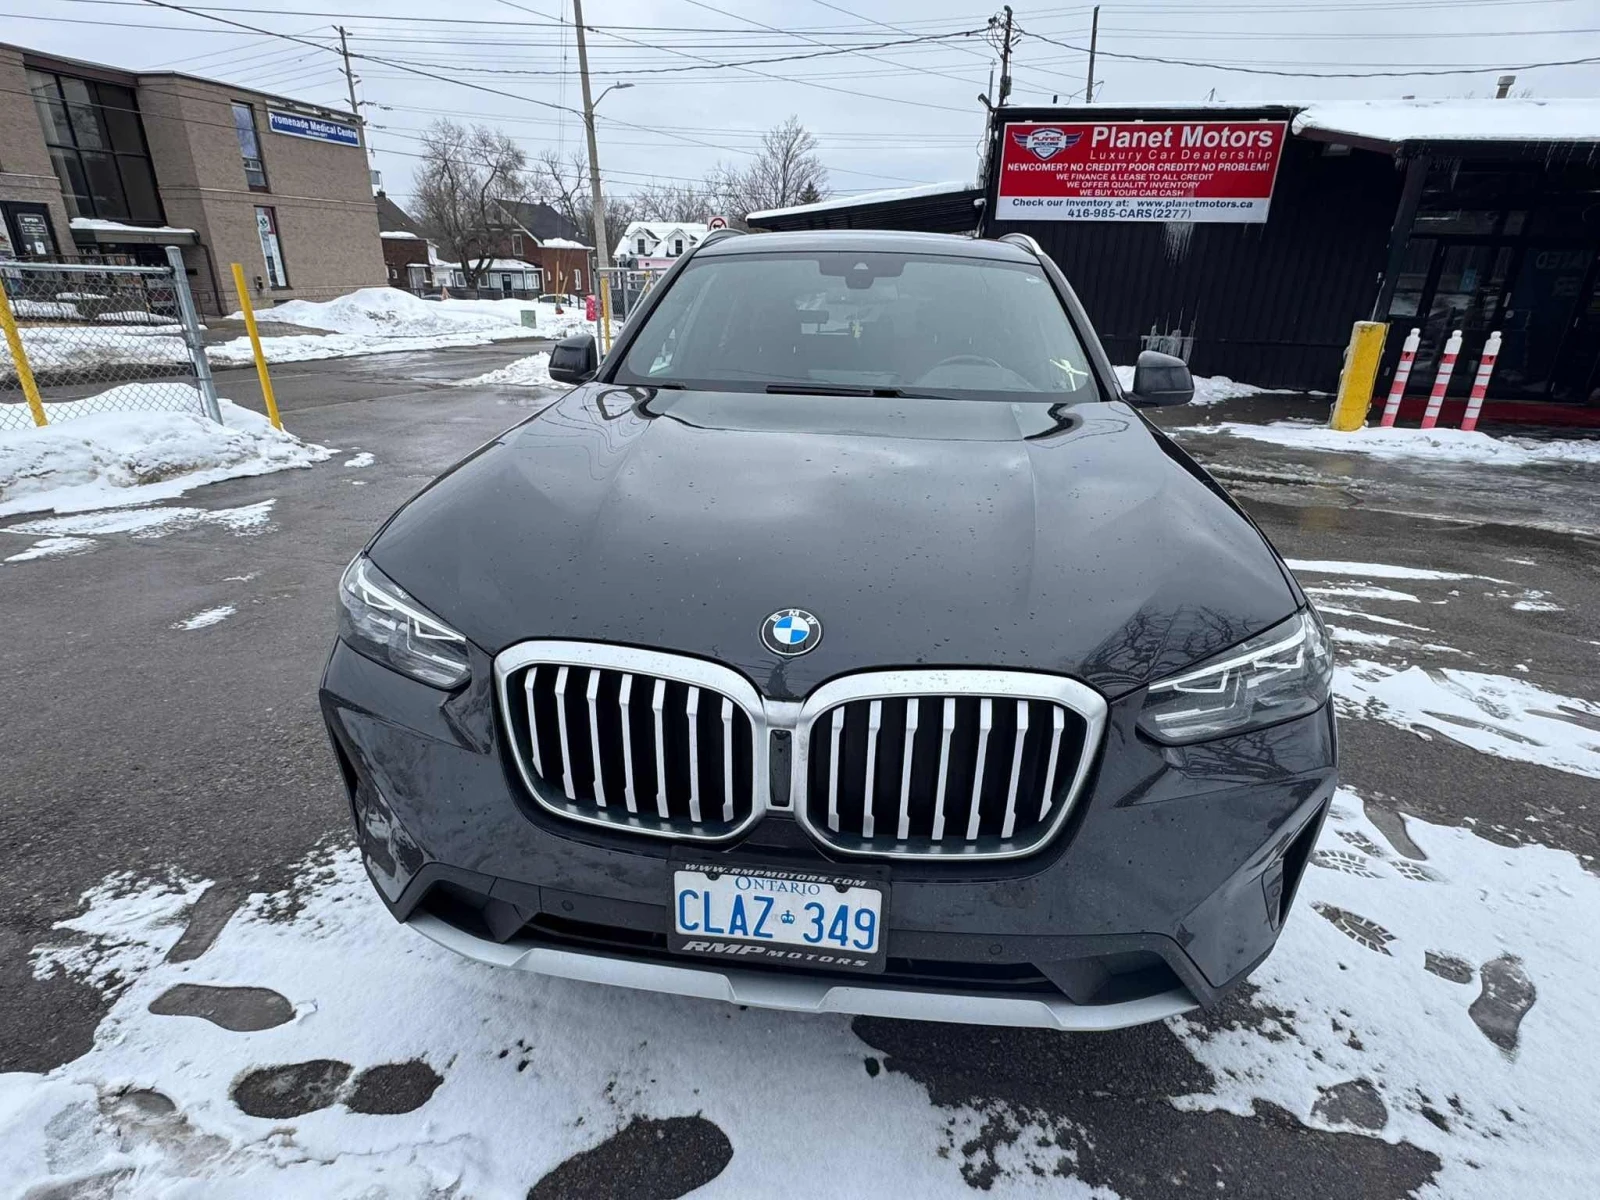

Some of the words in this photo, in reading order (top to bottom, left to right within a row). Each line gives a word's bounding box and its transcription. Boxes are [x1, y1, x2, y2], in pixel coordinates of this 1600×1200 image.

[270, 113, 309, 129] Promenade
[310, 121, 336, 134] Medical
[337, 127, 357, 138] Centre
[1092, 126, 1173, 148] Planet
[1180, 126, 1273, 148] Motors
[1090, 150, 1142, 162] Luxury
[1148, 150, 1175, 159] Car
[1181, 150, 1272, 161] Dealership
[1008, 163, 1068, 171] NEWCOMER?
[1070, 163, 1084, 171] NO
[1086, 163, 1126, 171] CREDIT?
[1128, 163, 1155, 171] POOR
[1157, 163, 1199, 171] CREDIT?
[1201, 163, 1216, 171] NO
[1218, 163, 1270, 171] PROBLEM!
[1012, 198, 1044, 206] Check
[1066, 199, 1112, 208] inventory
[1137, 200, 1253, 209] www.planetmotors.ca
[1068, 209, 1192, 219] 416-985-CARS(2277)
[770, 609, 816, 625] BMW
[684, 863, 867, 887] WWW.RMPMOTORS.COM
[735, 876, 820, 896] ONTARIO
[679, 890, 774, 938] CLAZ
[803, 901, 876, 950] 349
[682, 941, 766, 955] RMP
[766, 950, 869, 967] MOTORS
